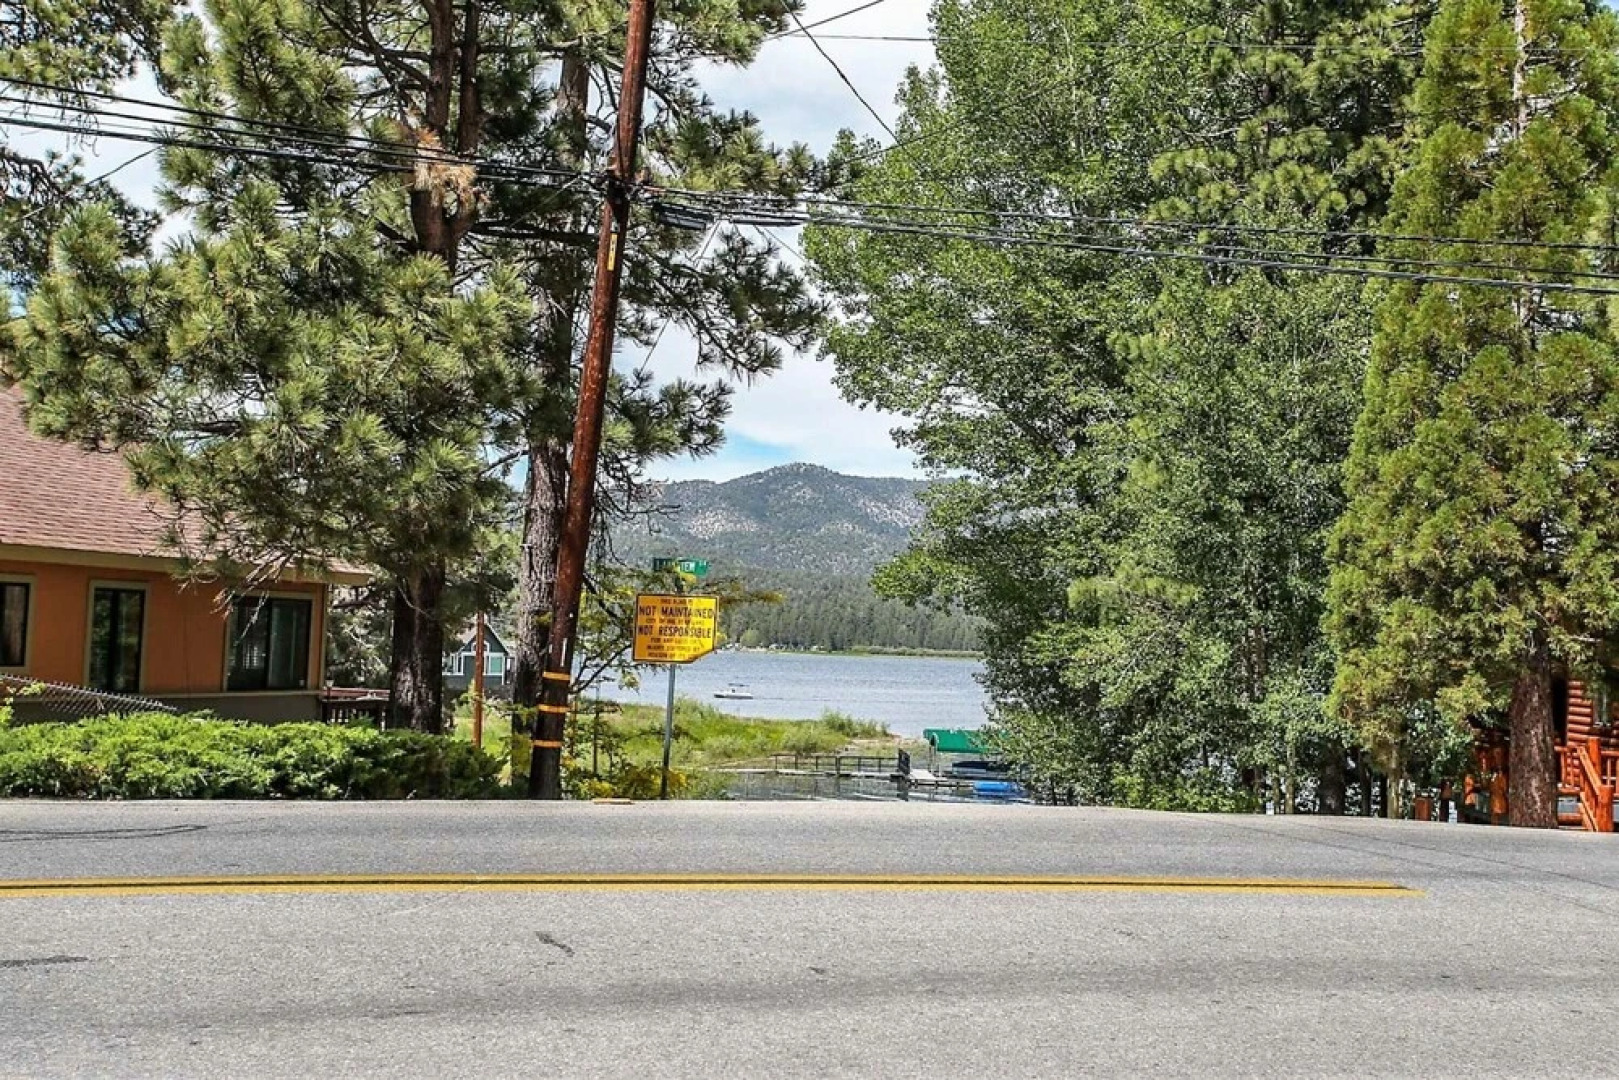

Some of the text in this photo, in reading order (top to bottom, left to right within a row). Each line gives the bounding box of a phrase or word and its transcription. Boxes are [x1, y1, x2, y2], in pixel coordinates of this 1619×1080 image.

[639, 605, 714, 619] NOT MAINTAINED
[638, 624, 711, 638] NOT RESPONSIBLE
